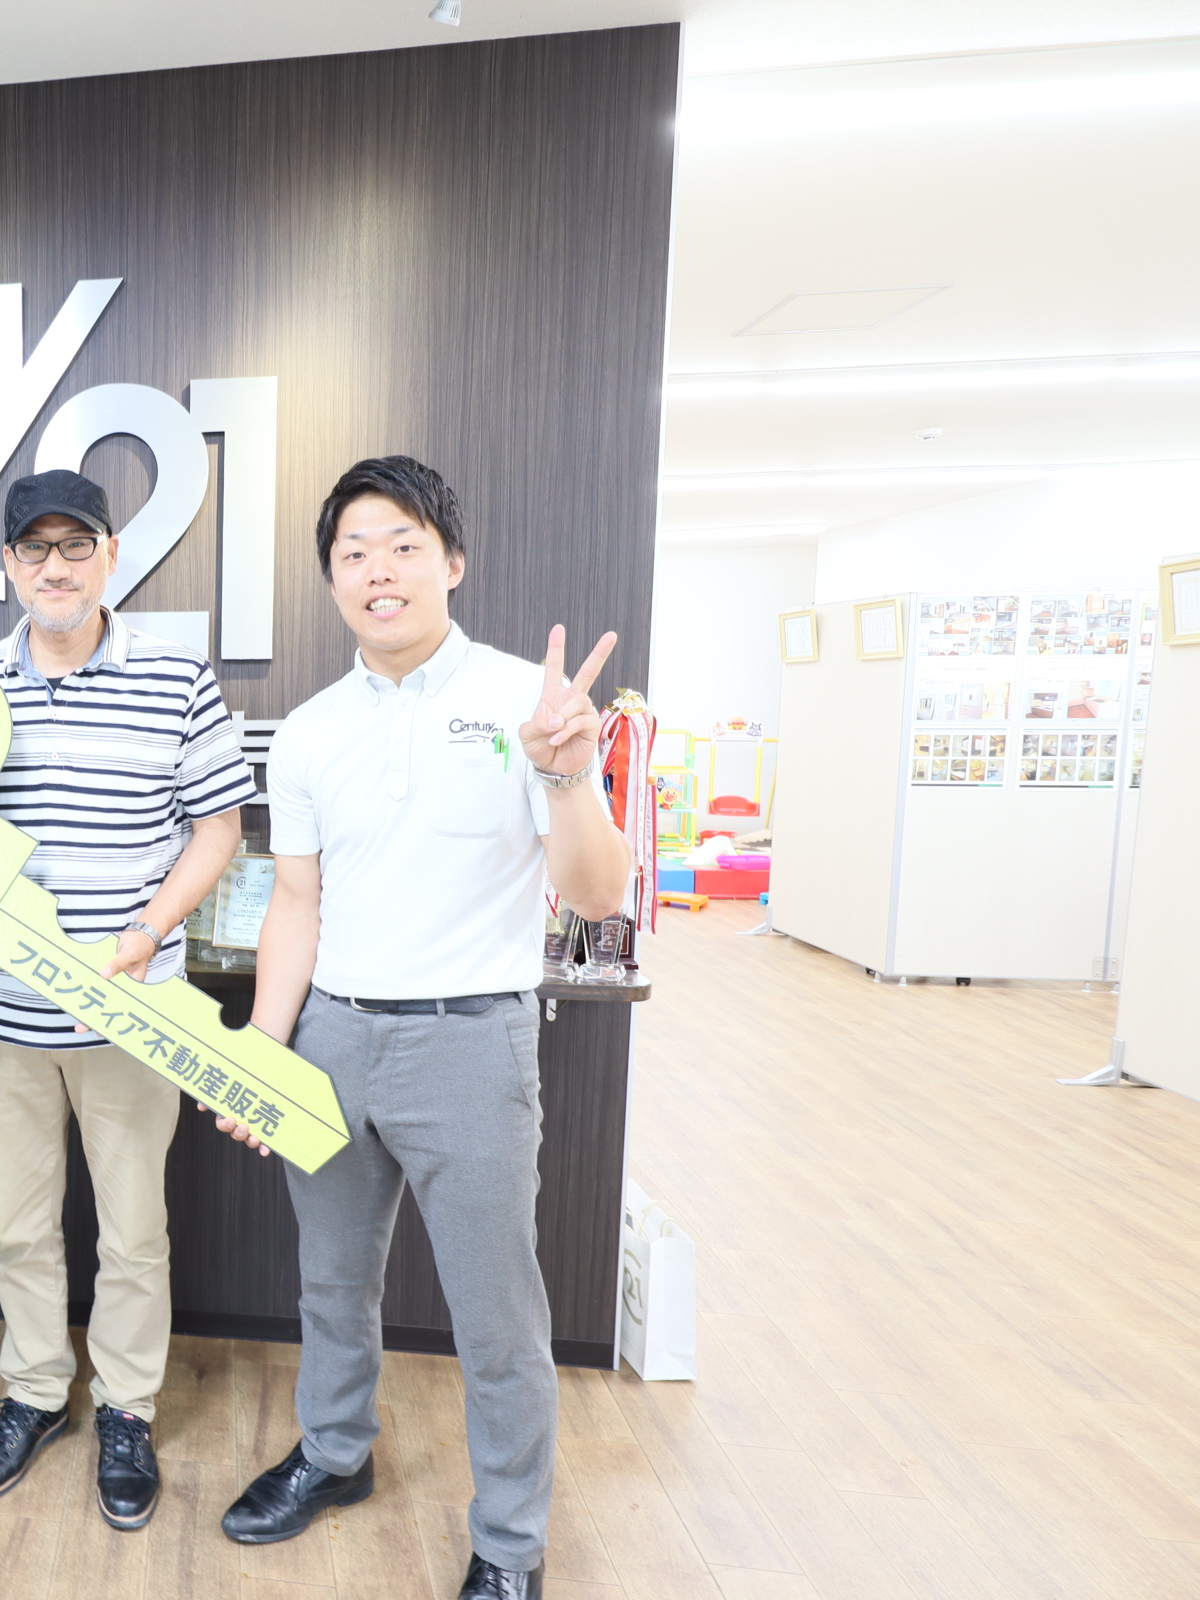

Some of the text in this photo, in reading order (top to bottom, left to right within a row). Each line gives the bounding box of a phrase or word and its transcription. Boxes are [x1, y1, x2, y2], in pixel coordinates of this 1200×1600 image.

[33, 375, 278, 660] 21
[448, 718, 496, 734] Century
[9, 940, 286, 1138] フロンティア不動産販売
